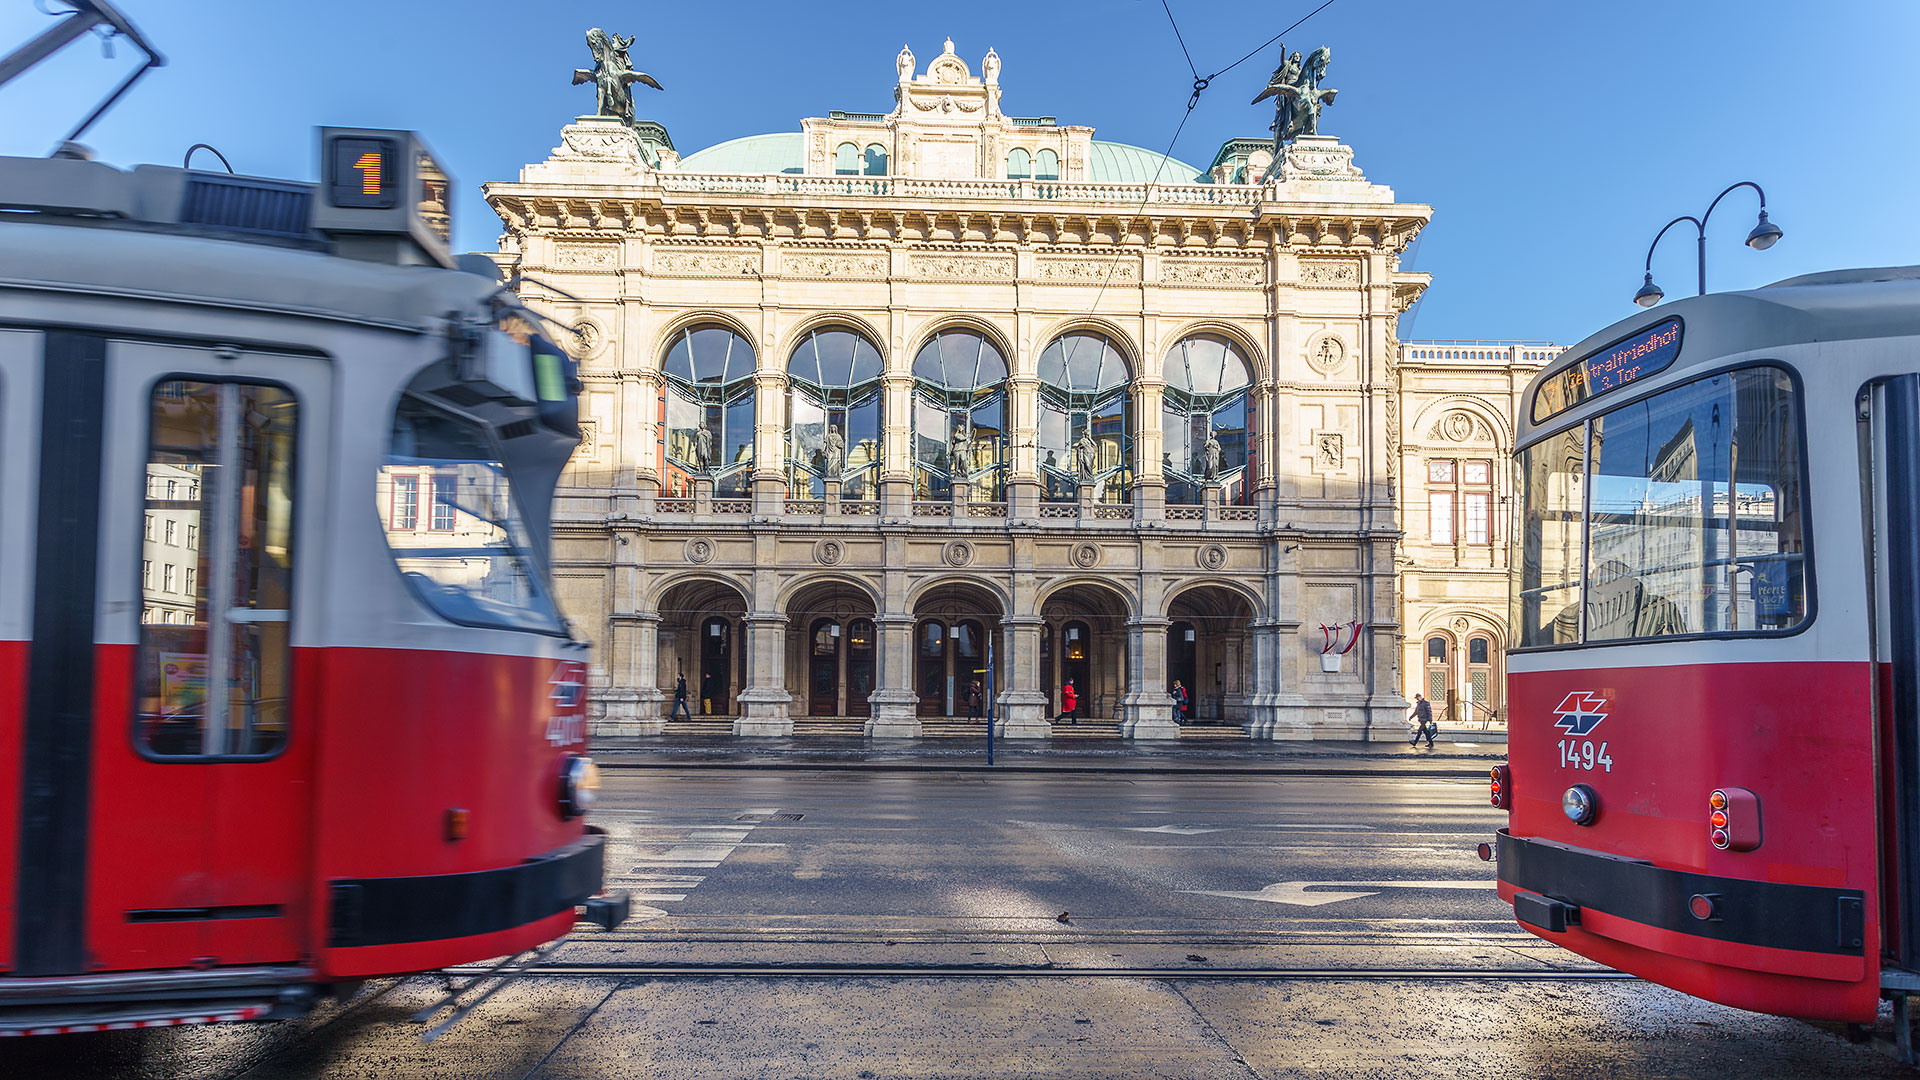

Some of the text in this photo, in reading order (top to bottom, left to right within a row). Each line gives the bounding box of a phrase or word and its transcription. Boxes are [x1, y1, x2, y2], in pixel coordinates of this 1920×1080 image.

[352, 152, 382, 195] 1
[1568, 322, 1679, 389] Zentralfriedhof
[1616, 365, 1641, 385] Tor
[1557, 738, 1614, 773] 1494
